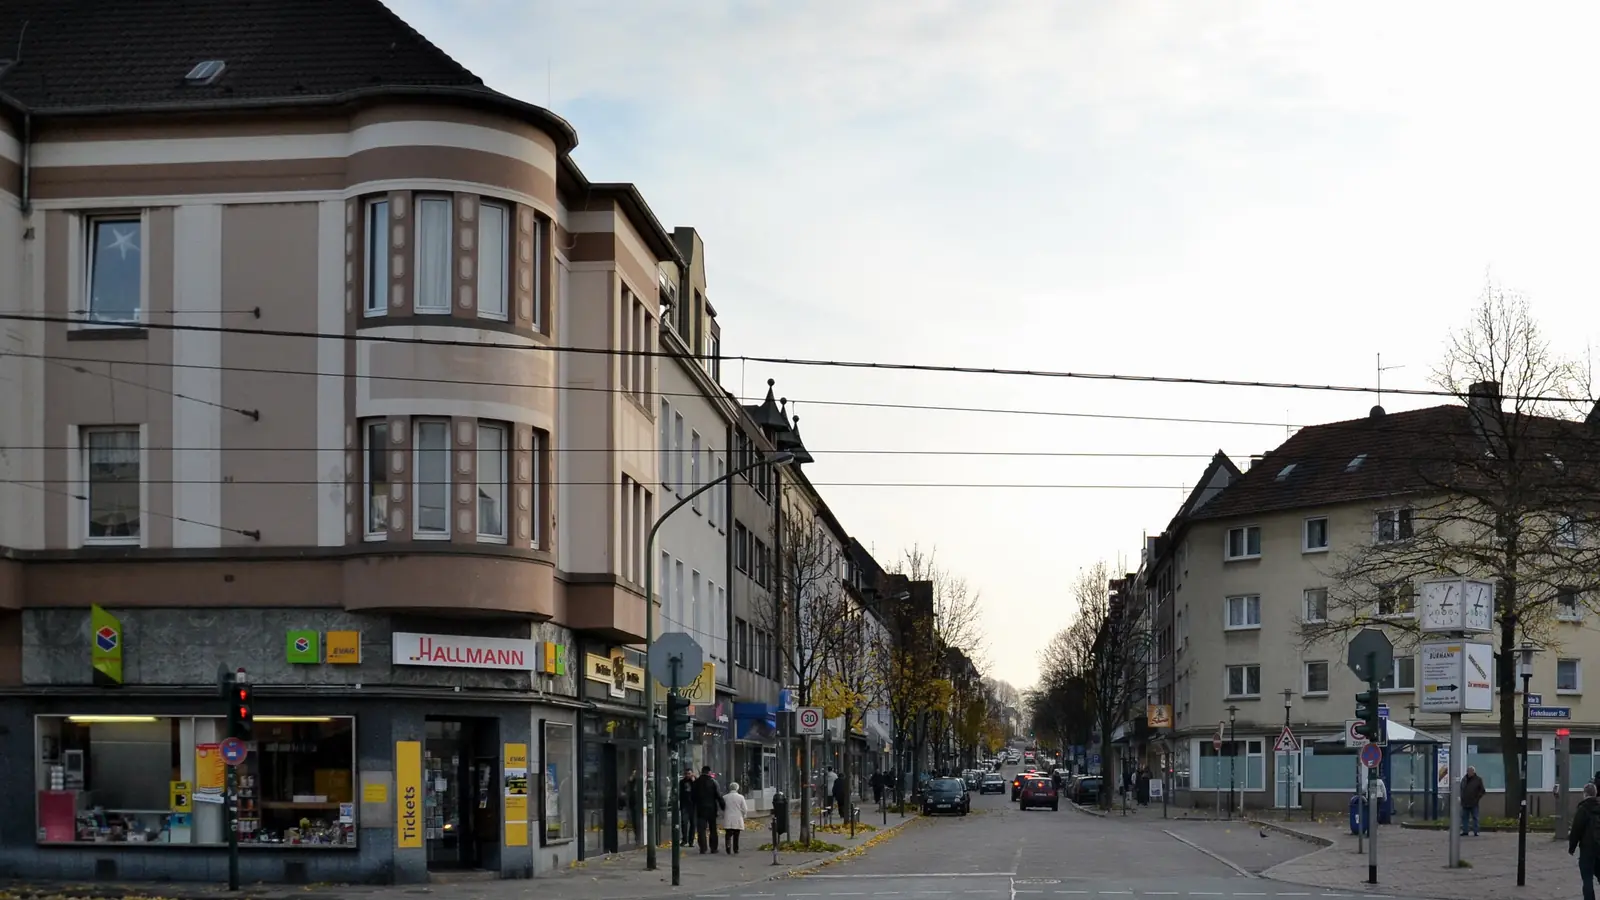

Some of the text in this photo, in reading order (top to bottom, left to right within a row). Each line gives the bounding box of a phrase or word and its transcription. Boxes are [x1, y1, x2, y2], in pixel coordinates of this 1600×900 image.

[418, 637, 524, 666] HALLMANN
[805, 714, 814, 722] 30
[403, 786, 416, 841] Tickets
